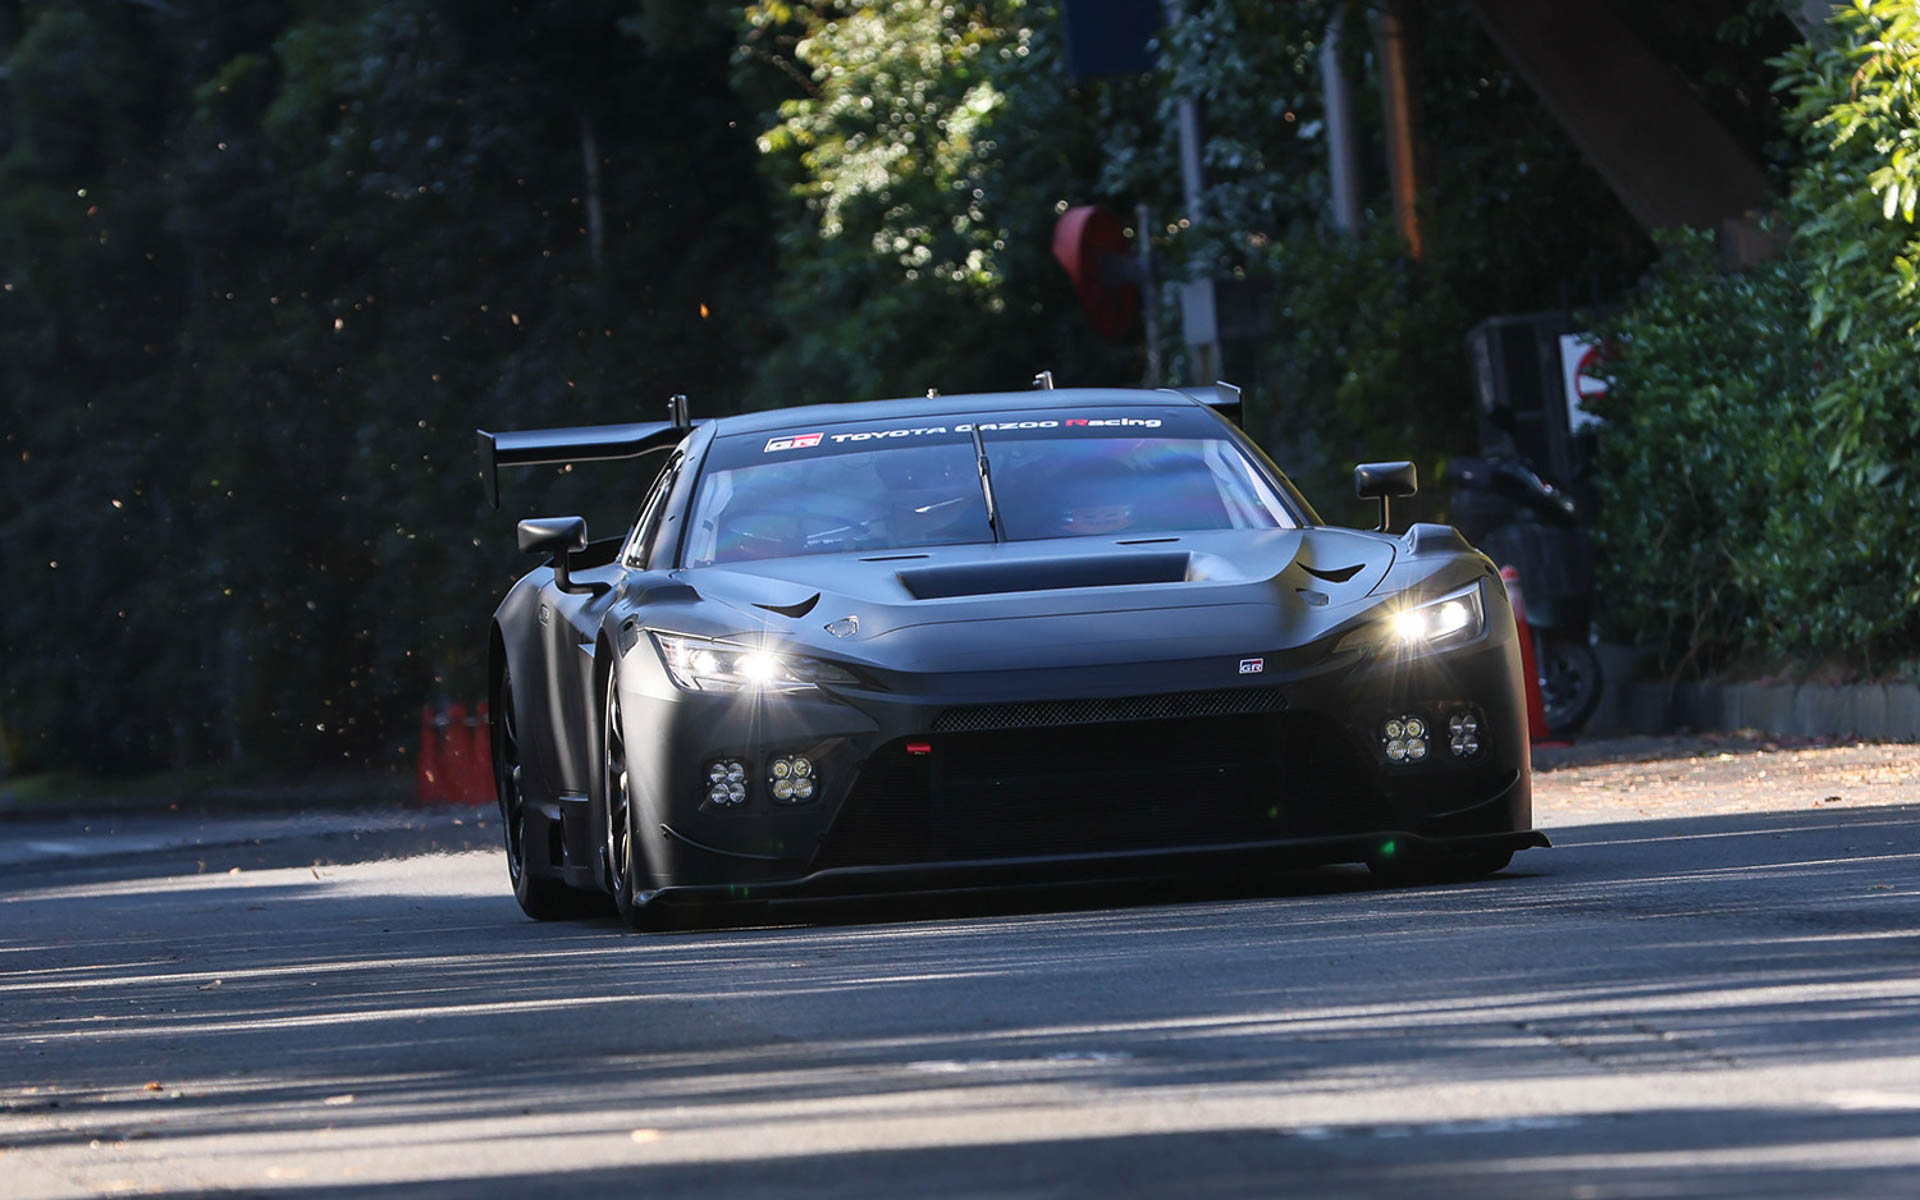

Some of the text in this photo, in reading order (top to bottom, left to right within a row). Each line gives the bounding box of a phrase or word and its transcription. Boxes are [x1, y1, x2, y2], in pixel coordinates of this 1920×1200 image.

[766, 417, 1162, 450] GR TOYOTA GAZOO Racing
[1241, 663, 1262, 673] GR
